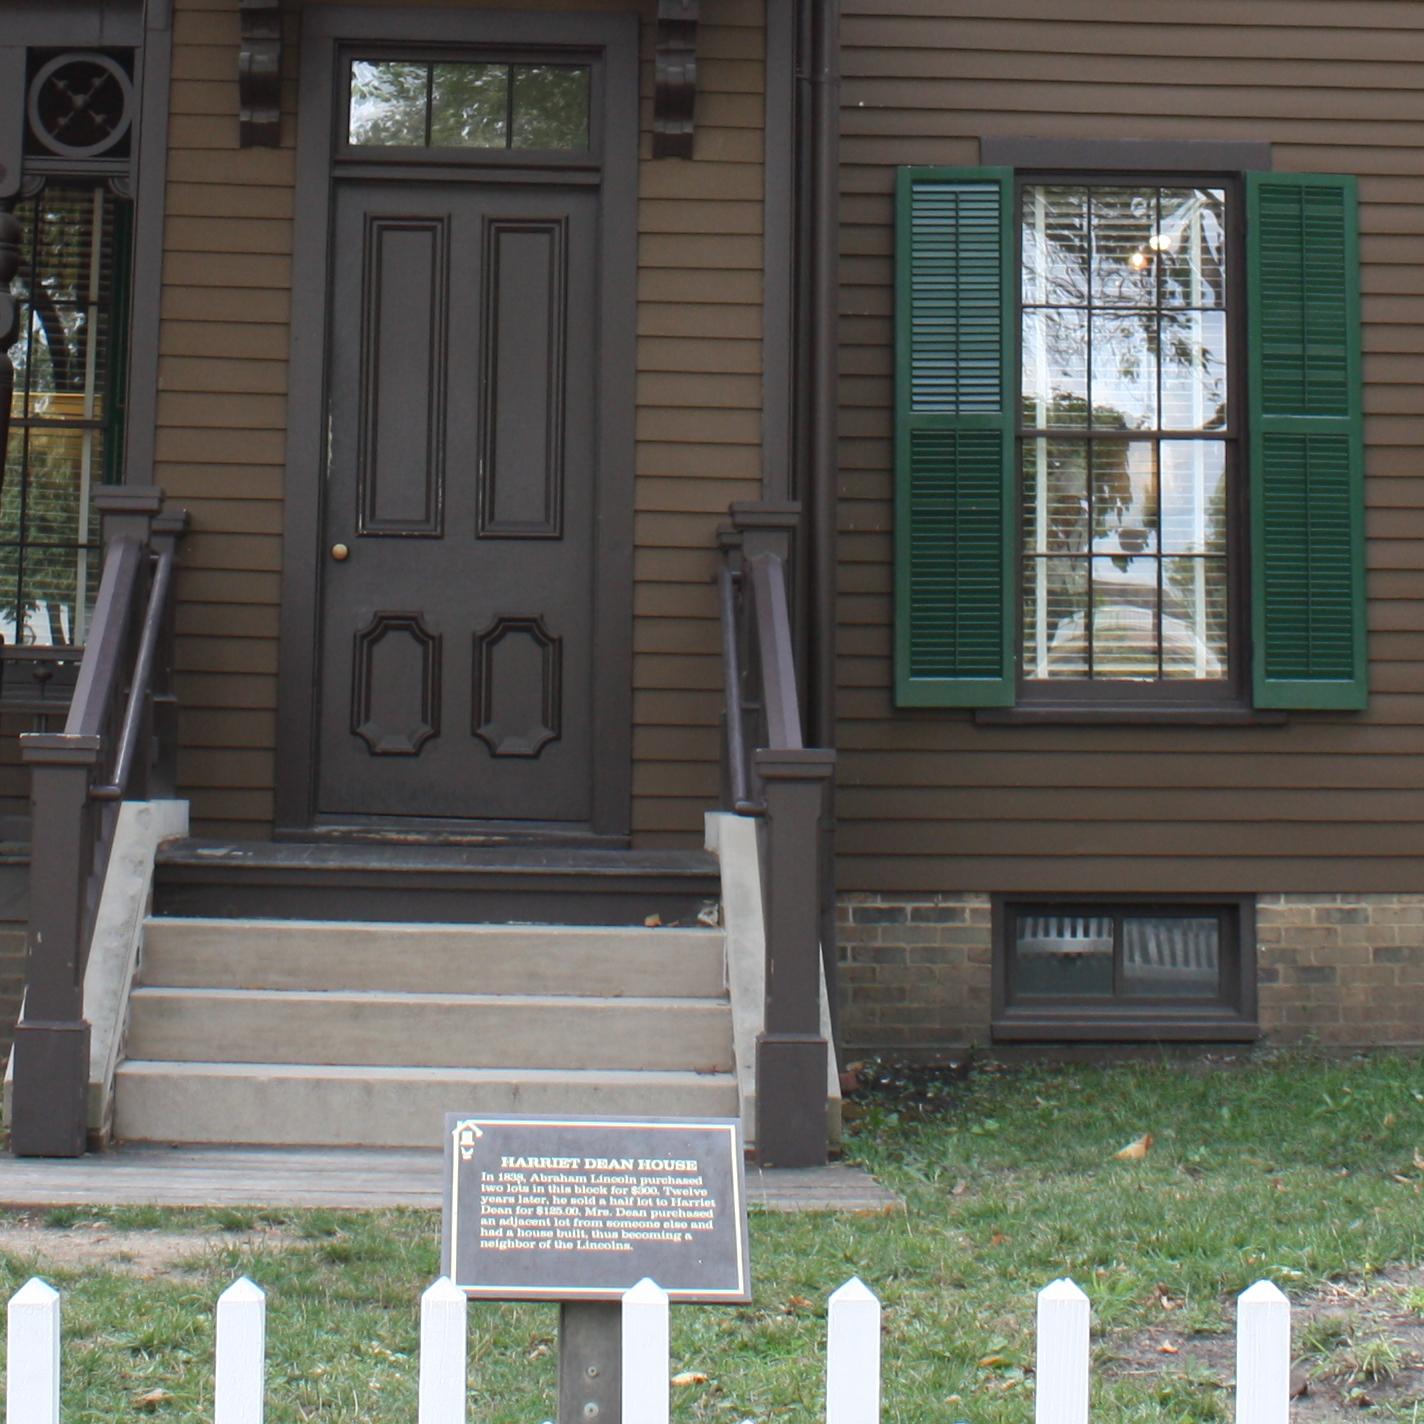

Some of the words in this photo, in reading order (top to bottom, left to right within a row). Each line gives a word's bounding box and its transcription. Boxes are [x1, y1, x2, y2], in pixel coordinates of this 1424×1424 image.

[501, 1156, 580, 1168] HARRIET
[583, 1157, 634, 1170] DEAN
[638, 1159, 697, 1171] HOUSE
[481, 1171, 494, 1181] In
[530, 1173, 587, 1183] Abraham
[590, 1174, 636, 1184] Lincoln
[640, 1176, 703, 1186] purchased
[481, 1184, 503, 1192] two
[507, 1184, 529, 1193] lots
[532, 1184, 545, 1193] in
[548, 1184, 571, 1193] this
[574, 1185, 607, 1194] block
[611, 1186, 628, 1195] for
[663, 1187, 708, 1196] Twelve
[480, 1195, 515, 1204] years
[552, 1195, 567, 1204] he
[570, 1196, 596, 1205] sold
[599, 1198, 607, 1206] a
[609, 1196, 634, 1206] half
[637, 1197, 653, 1206] lot
[656, 1197, 668, 1206] to
[671, 1197, 716, 1207] Harriet
[481, 1205, 512, 1214] Dean
[516, 1205, 534, 1214] for
[585, 1207, 612, 1216] Mrs.
[616, 1207, 647, 1217] Dean
[650, 1208, 714, 1219] purchased
[480, 1217, 496, 1225] an
[499, 1216, 550, 1227] adjacent
[554, 1217, 571, 1226] lot
[573, 1218, 605, 1227] from
[606, 1220, 660, 1228] someone
[663, 1220, 688, 1229] else
[690, 1220, 714, 1229] and
[480, 1227, 503, 1236] had
[506, 1228, 514, 1237] a
[517, 1227, 553, 1237] house
[591, 1229, 618, 1239] thus
[621, 1229, 681, 1241] becoming
[684, 1232, 693, 1240] a
[480, 1238, 536, 1250] neighbor
[538, 1239, 552, 1249] of
[554, 1239, 573, 1249] the
[577, 1239, 633, 1250] Lincolns.
